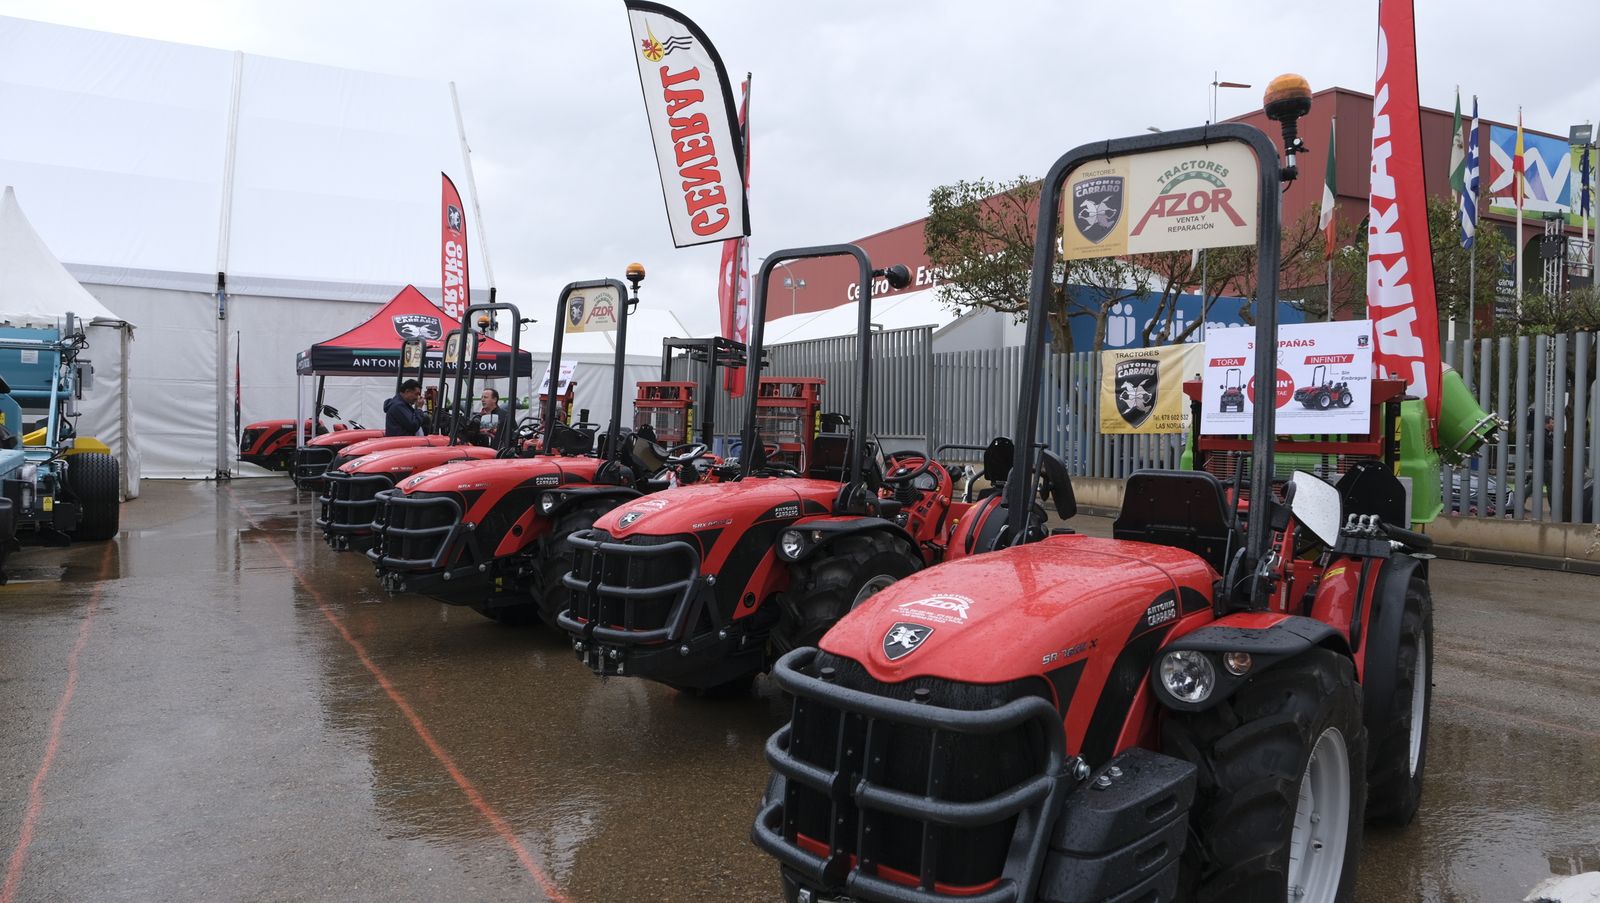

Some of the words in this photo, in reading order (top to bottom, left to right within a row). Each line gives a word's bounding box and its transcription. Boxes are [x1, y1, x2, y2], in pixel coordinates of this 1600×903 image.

[1082, 168, 1116, 178] TRACTORES
[1157, 160, 1230, 185] TRACTORES
[1075, 179, 1121, 191] ANTONIO
[1076, 185, 1120, 198] CARRARO
[1130, 188, 1247, 236] AZOR
[1176, 216, 1199, 224] VENTA
[1168, 222, 1214, 233] REPARACIÓN
[848, 278, 889, 300] Cetro
[585, 306, 616, 324] AZOR
[1248, 342, 1254, 350] 3
[1277, 339, 1316, 349] PAÑAS
[1116, 350, 1160, 359] TRACTORES
[1310, 355, 1348, 364] INFINITY
[1117, 362, 1157, 371] ANTONIO
[1118, 368, 1155, 378] CARRARO
[898, 599, 970, 619] AZOR
[1147, 600, 1175, 616] ANTONIO
[1148, 608, 1176, 626] CARRARO
[1042, 652, 1058, 665] SR
